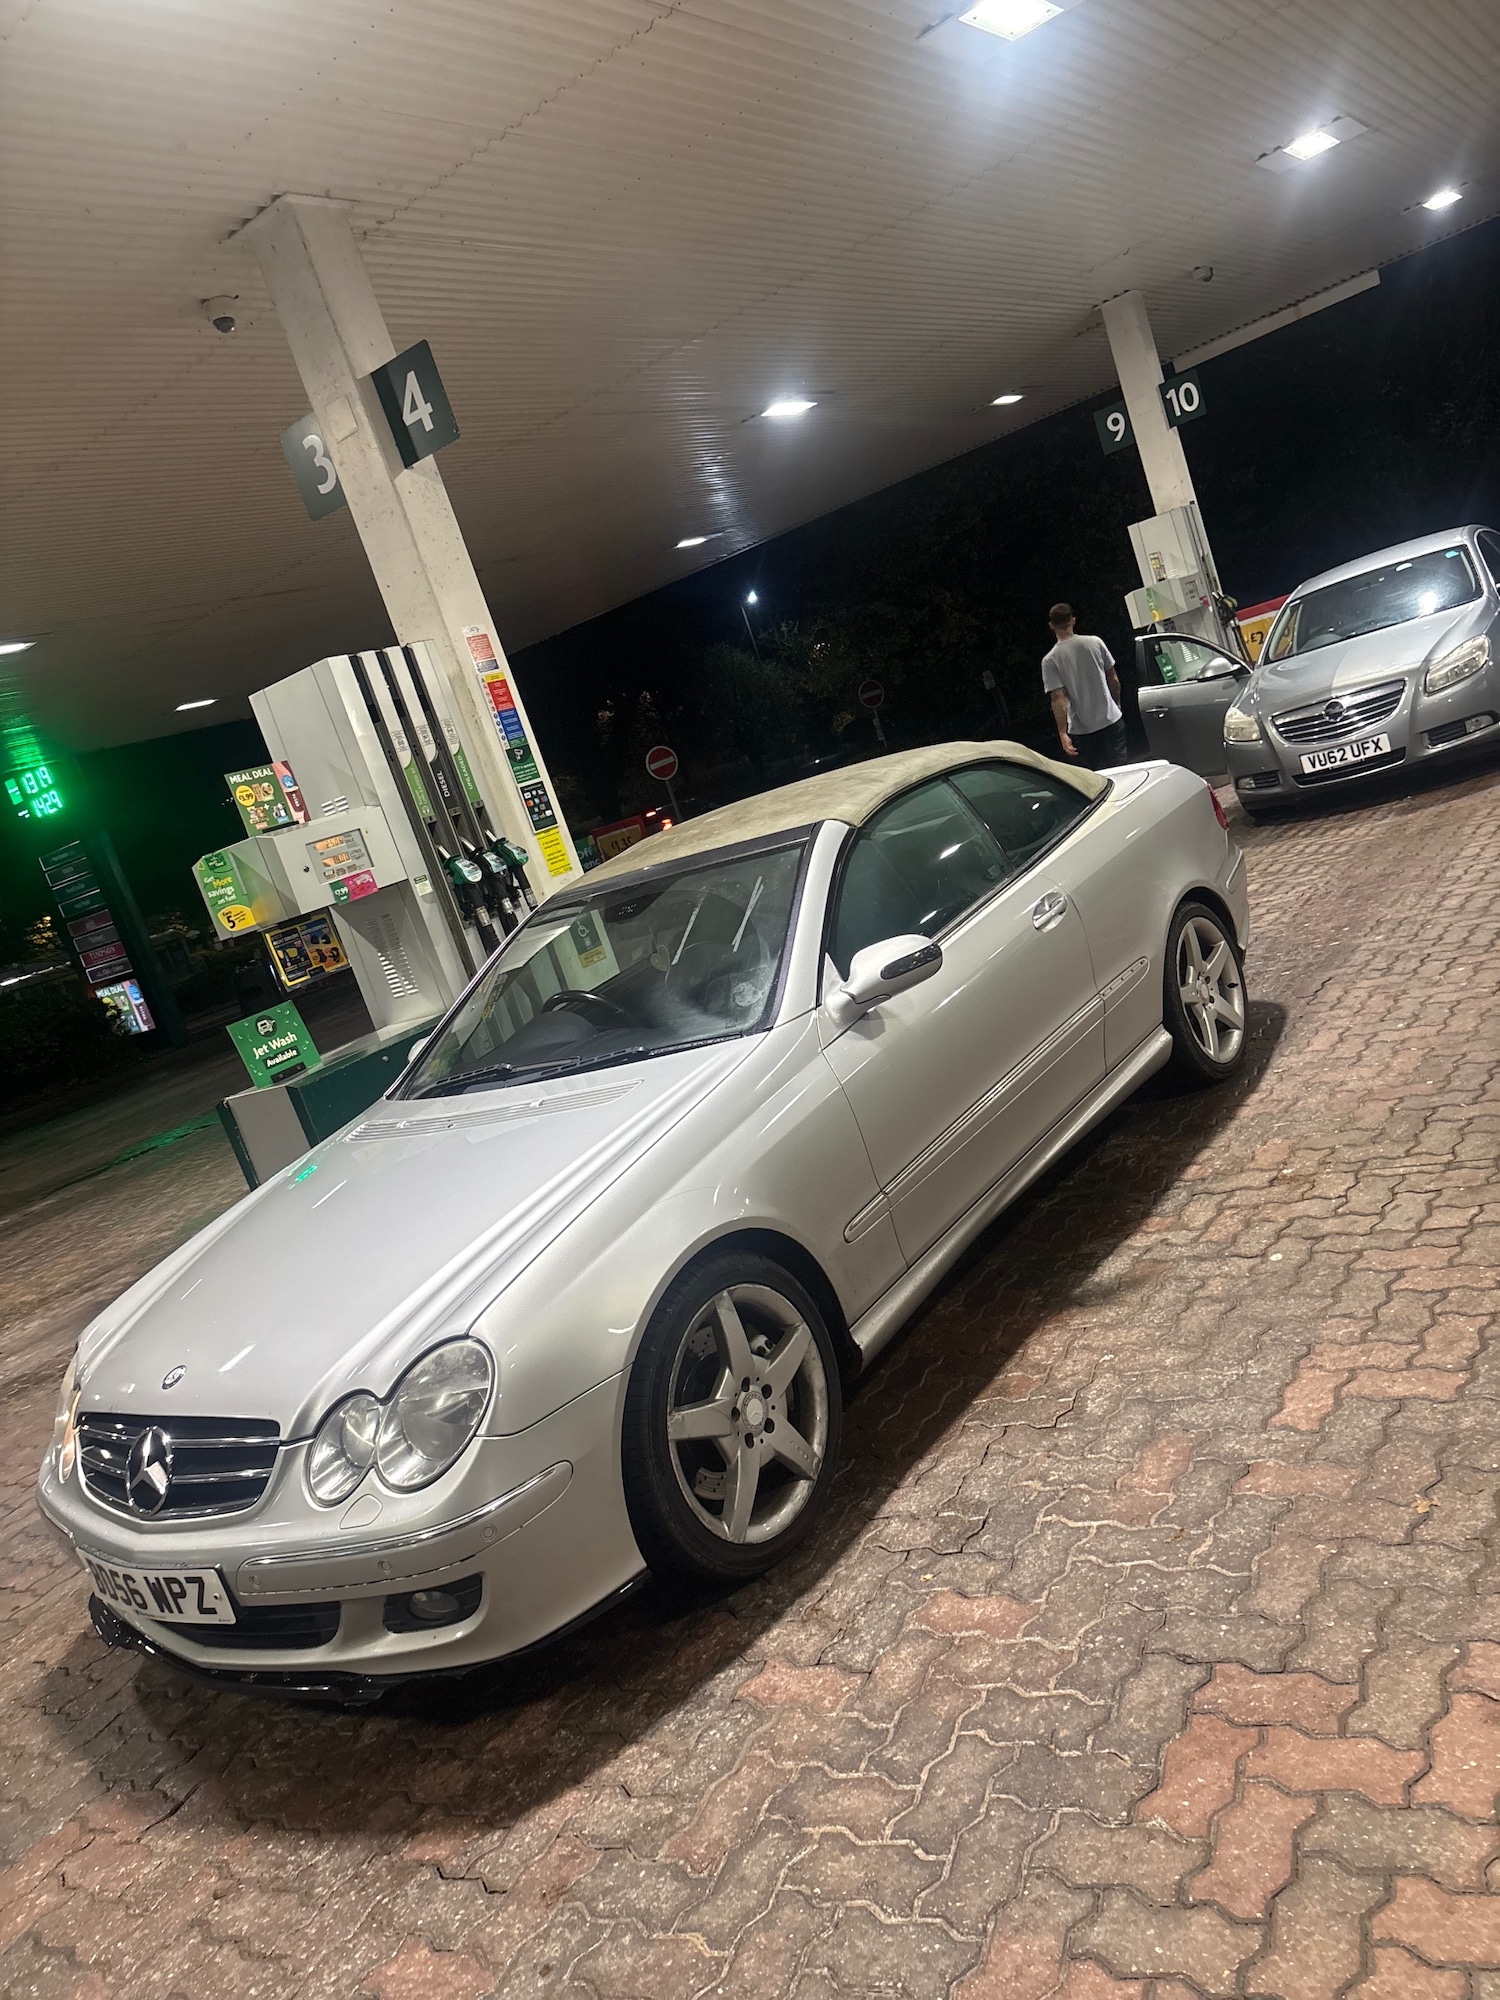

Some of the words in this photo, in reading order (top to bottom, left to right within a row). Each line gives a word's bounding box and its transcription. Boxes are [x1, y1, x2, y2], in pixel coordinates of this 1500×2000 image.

[402, 370, 434, 432] 4
[1165, 382, 1199, 417] 10
[1106, 412, 1125, 442] 9
[302, 434, 337, 494] 3
[1308, 748, 1348, 769] VU62
[1350, 738, 1383, 758] UFX
[229, 771, 253, 785] MEAL
[252, 767, 274, 780] DEAL
[457, 754, 473, 790] UNLEADED
[436, 770, 450, 798] DIESEL
[238, 792, 254, 803] £3.99
[203, 876, 215, 884] Get
[212, 875, 232, 889] More
[207, 885, 235, 899] savings
[217, 897, 226, 905] on
[225, 894, 236, 904] fuel
[227, 915, 236, 929] 5
[96, 986, 112, 999] MEAL
[111, 983, 125, 995] DEAL
[253, 1044, 270, 1060] Jet
[270, 1032, 298, 1051] Wash
[266, 1049, 298, 1067] Available
[144, 1576, 218, 1615] WPZ
